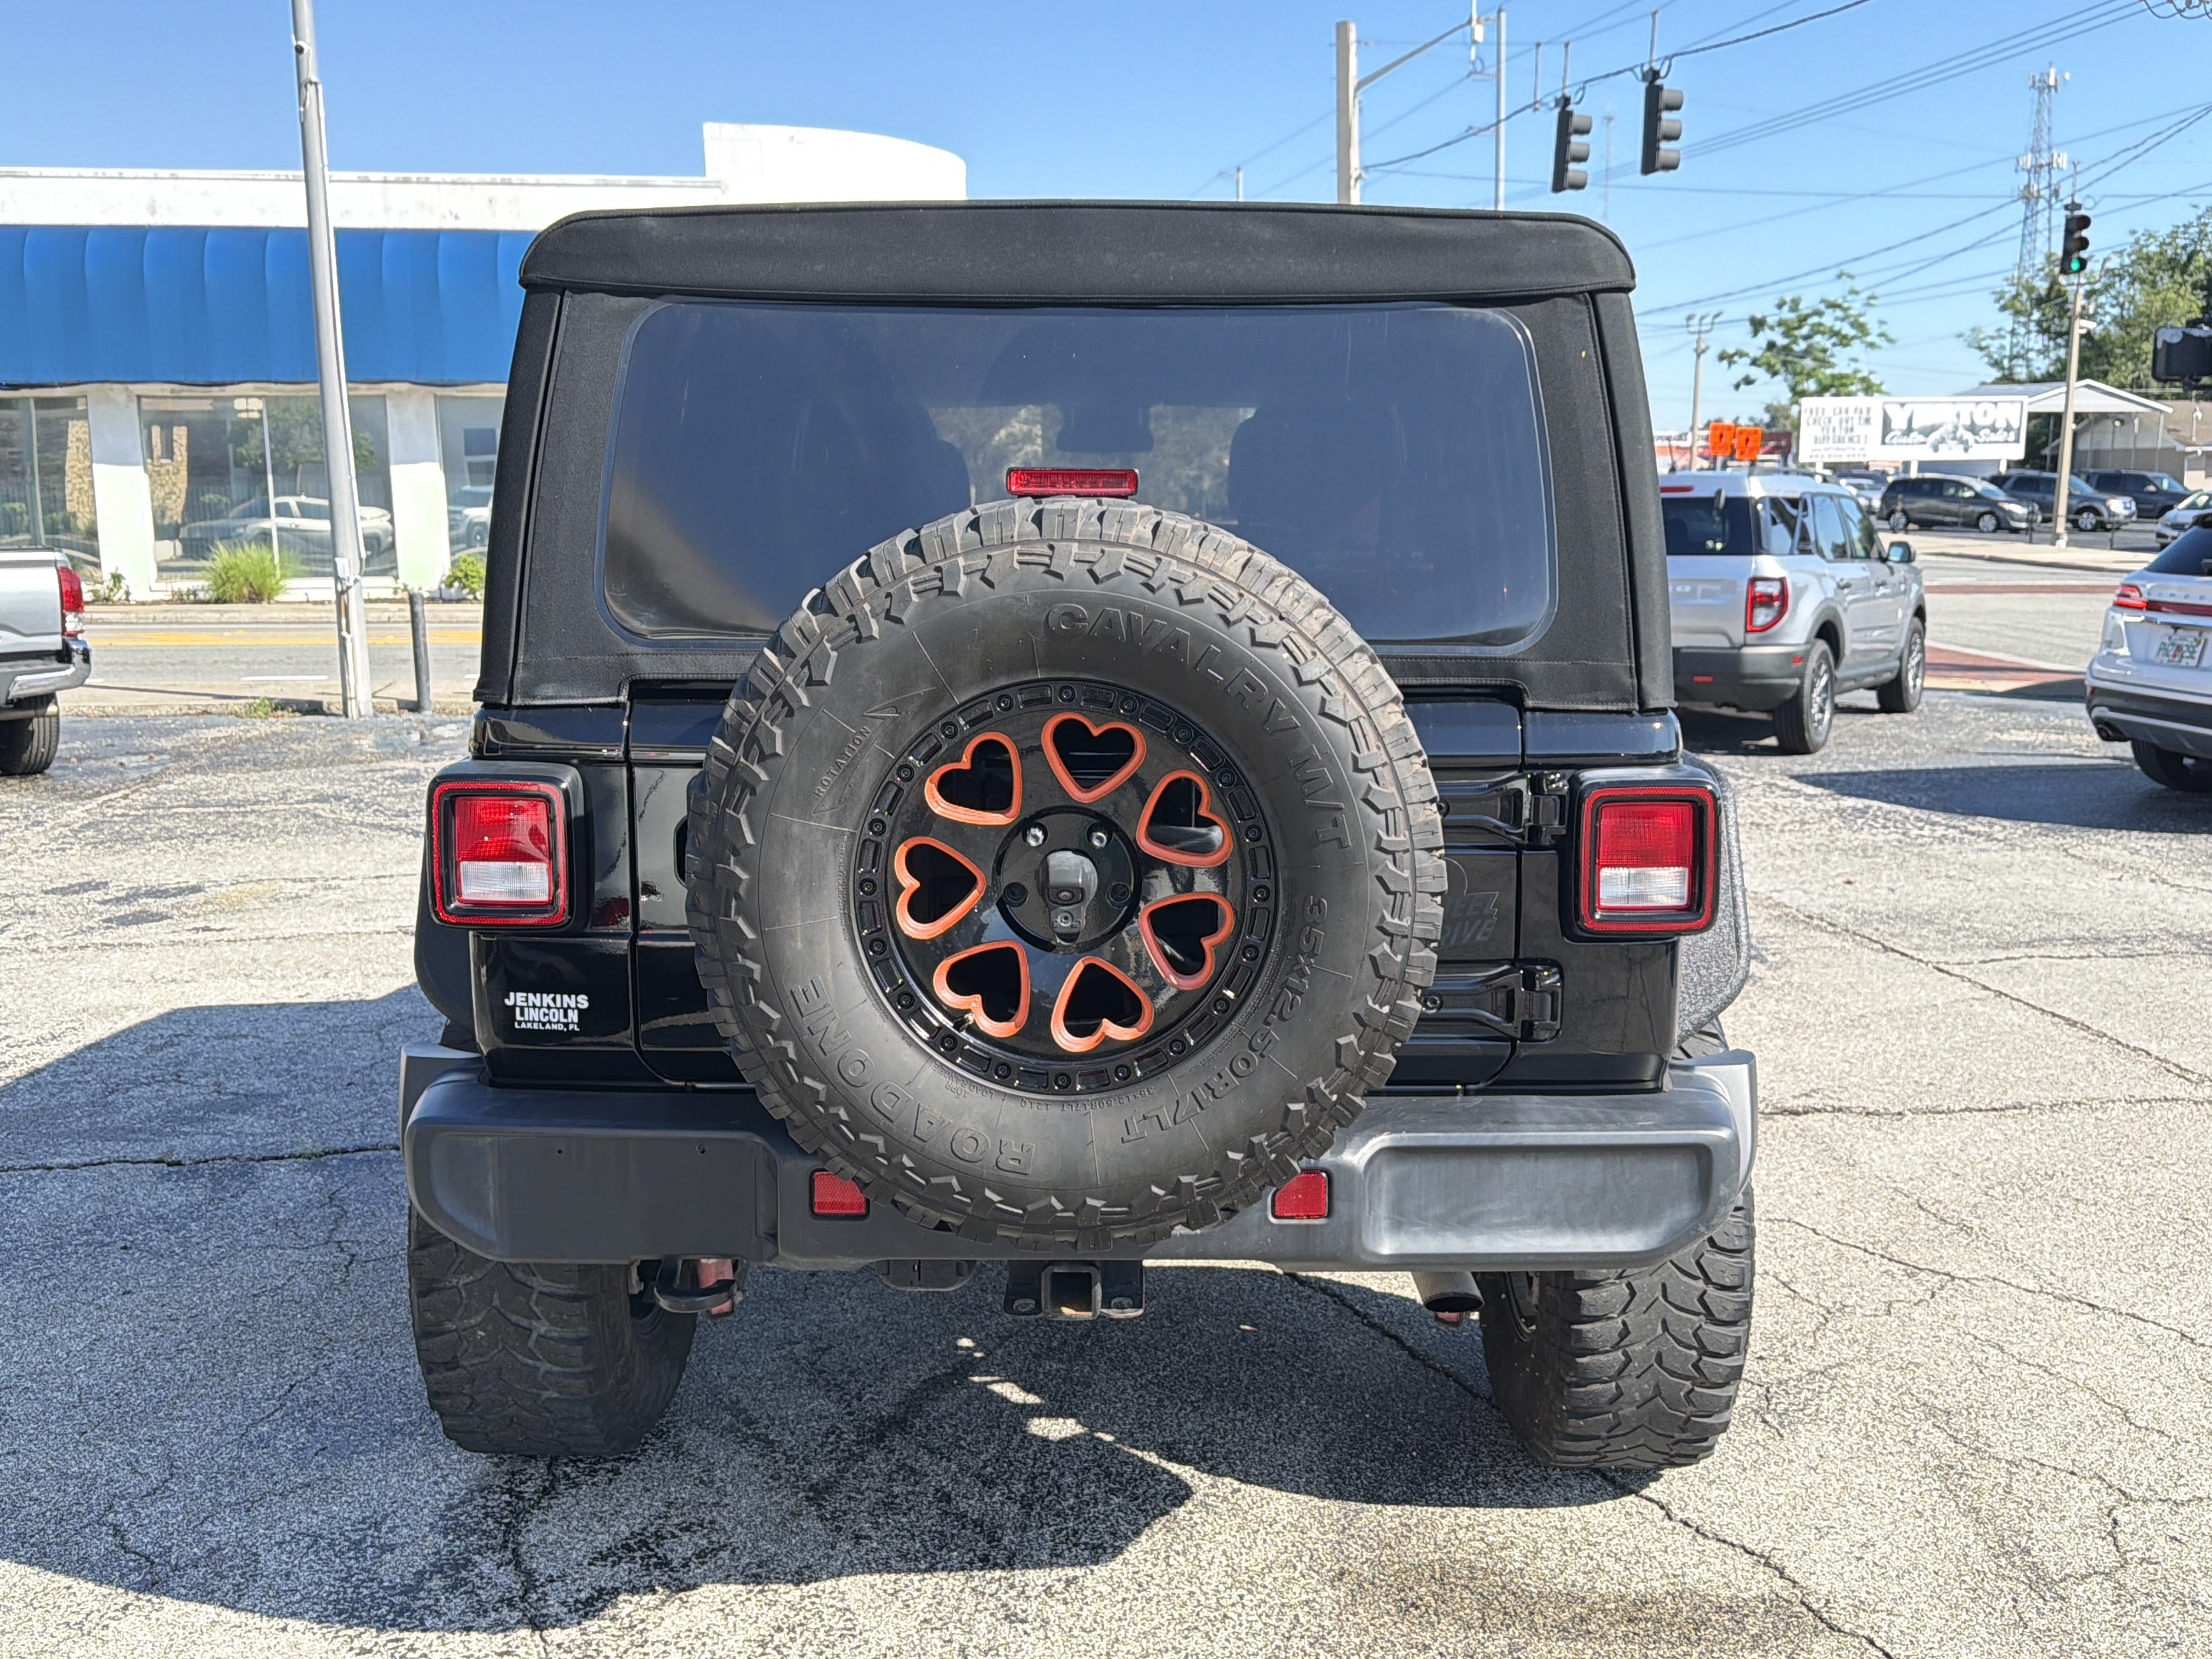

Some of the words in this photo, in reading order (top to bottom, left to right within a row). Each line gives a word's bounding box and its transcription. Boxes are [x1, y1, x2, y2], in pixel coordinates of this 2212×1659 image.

[1043, 602, 1301, 735] CAVALRY
[812, 725, 871, 798] ROTATION
[504, 992, 589, 1008] JENKINS
[515, 1007, 578, 1023] LINCOLN
[515, 1022, 567, 1031] LAKELAND,
[788, 976, 1039, 1176] ROADONE
[968, 1082, 995, 1099] LOAD
